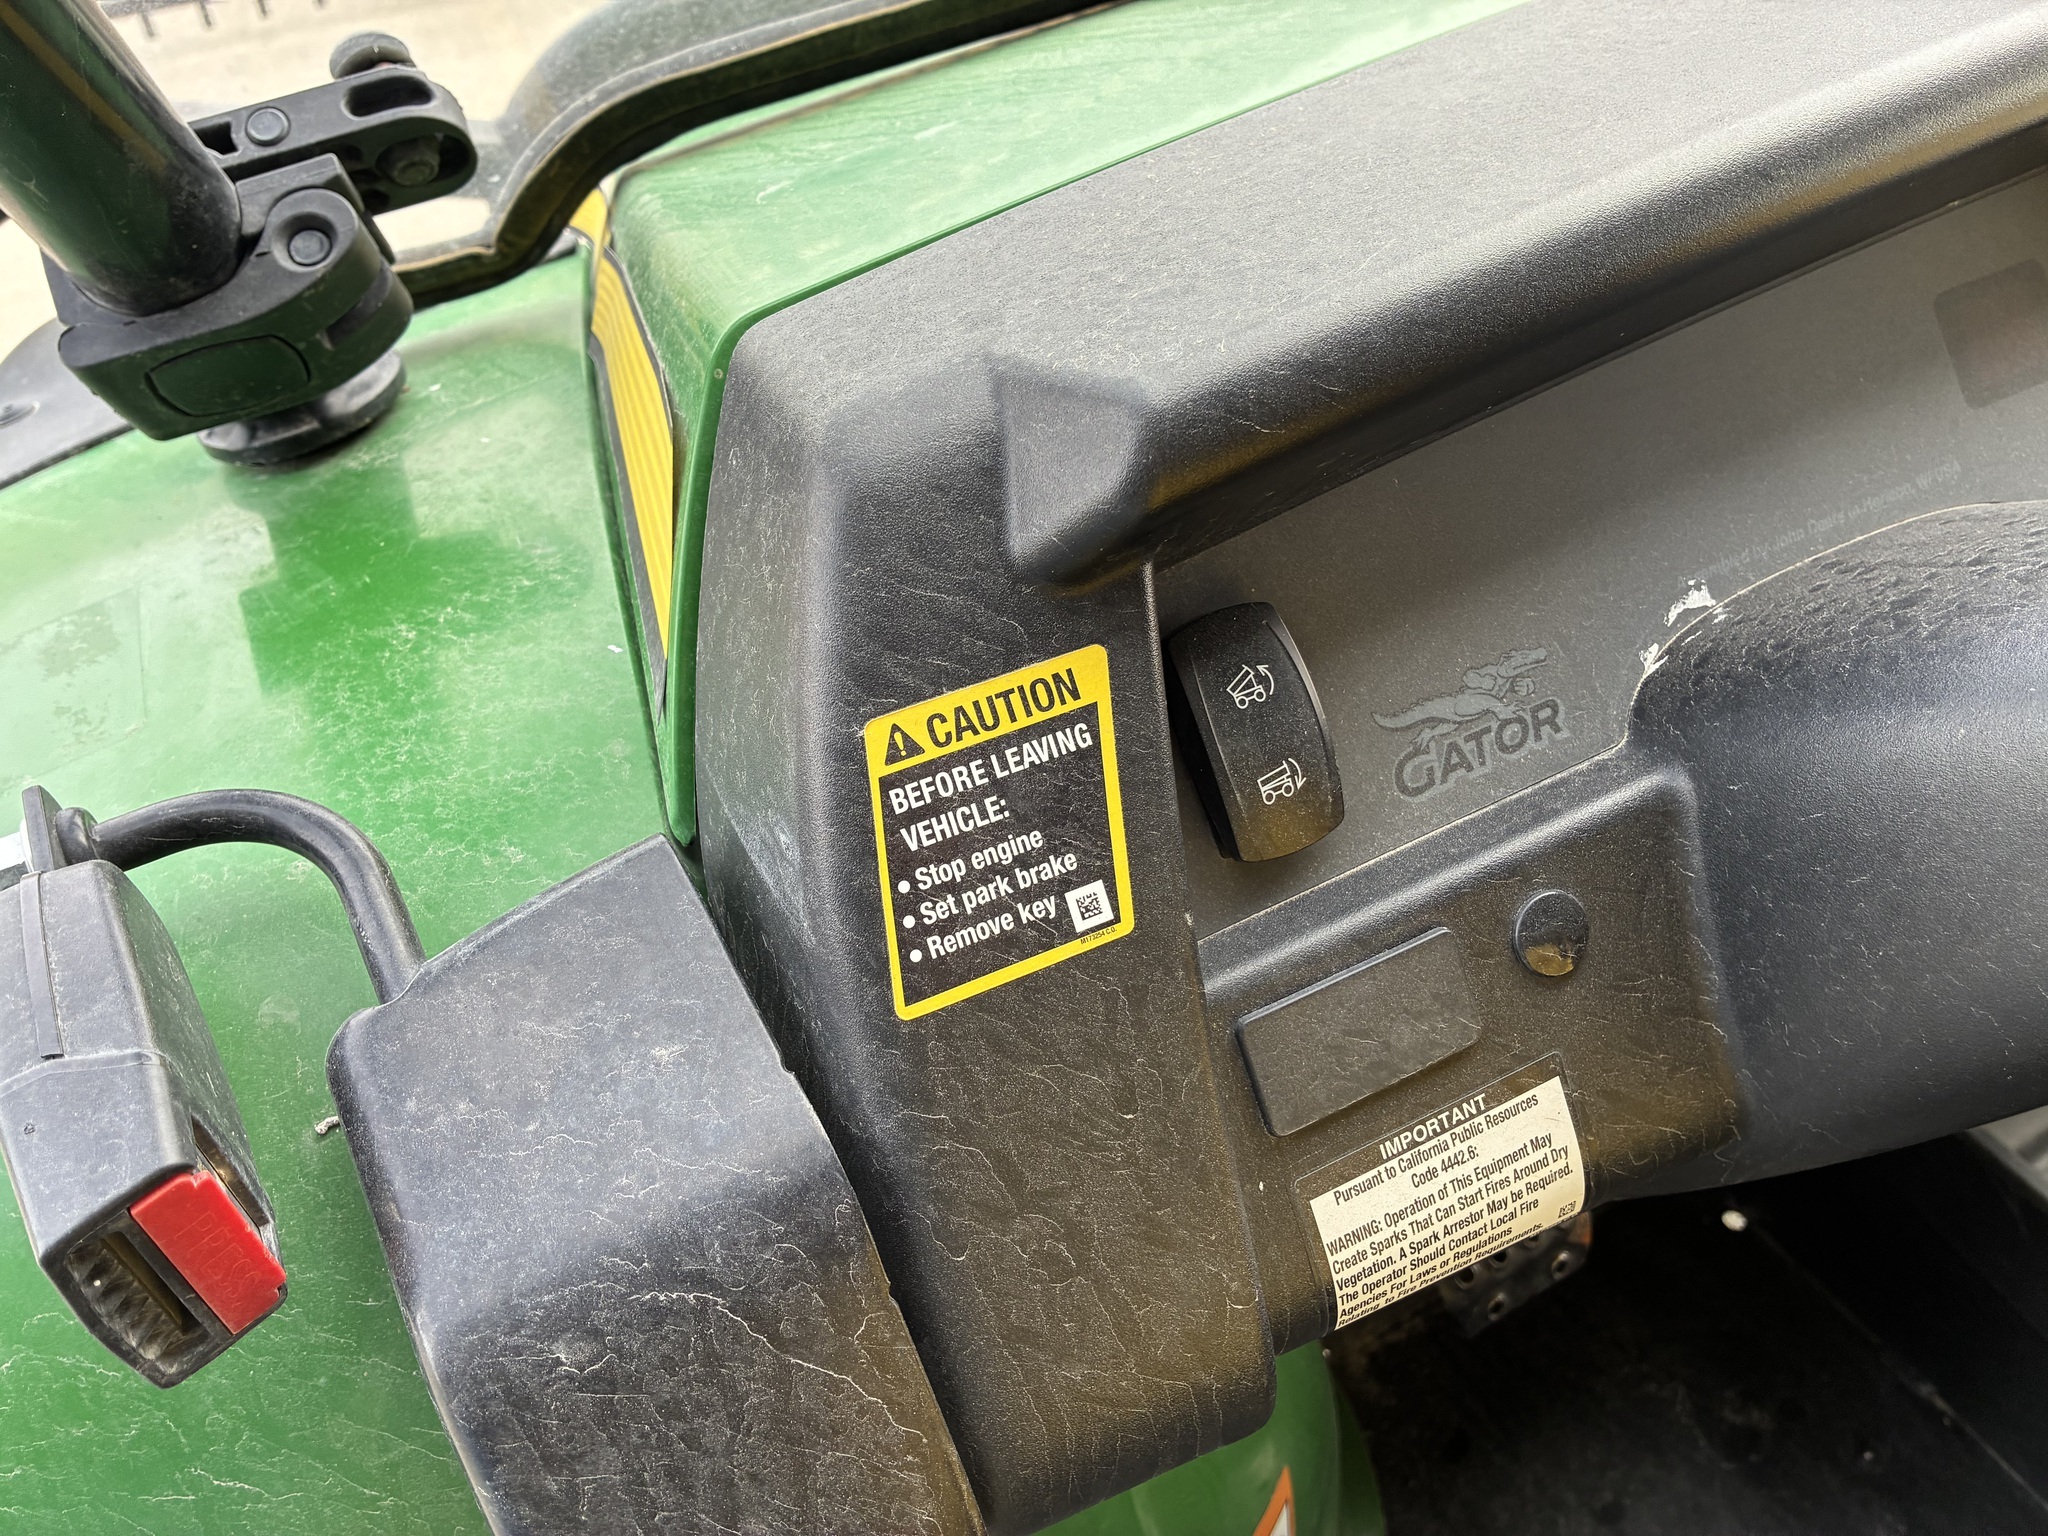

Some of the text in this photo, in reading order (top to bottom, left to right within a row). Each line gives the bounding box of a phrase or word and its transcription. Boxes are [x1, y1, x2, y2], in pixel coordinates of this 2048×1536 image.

[926, 667, 1082, 748] CAUTION
[1394, 697, 1564, 797] GATOR
[888, 722, 1093, 815] BEFORE LEAVING
[900, 795, 1010, 851] VEHICLE:
[914, 830, 1044, 890] Stop engine
[919, 852, 1078, 925] Set park brake
[926, 894, 1056, 959] Remove key
[1333, 1094, 1539, 1206] Pursuant to California Public Resources
[1379, 1093, 1486, 1160] IMPORTANT
[1411, 1145, 1480, 1189] Code 4442.6:
[1326, 1132, 1552, 1257] WARNING: Operation of This Equipment May
[1332, 1145, 1569, 1275] Create Sparks That Can Start Fires Around Dry
[1336, 1161, 1574, 1291] Vegetation. A Spark Arrestor May be Required.
[173, 1210, 262, 1308] PRESS
[1337, 1222, 1544, 1328] Relating to Fire Prevention Requirements.
[1338, 1197, 1540, 1306] The Operator Should Contact Local Fire
[1340, 1226, 1513, 1319] Agencies For Laws or Regulations
